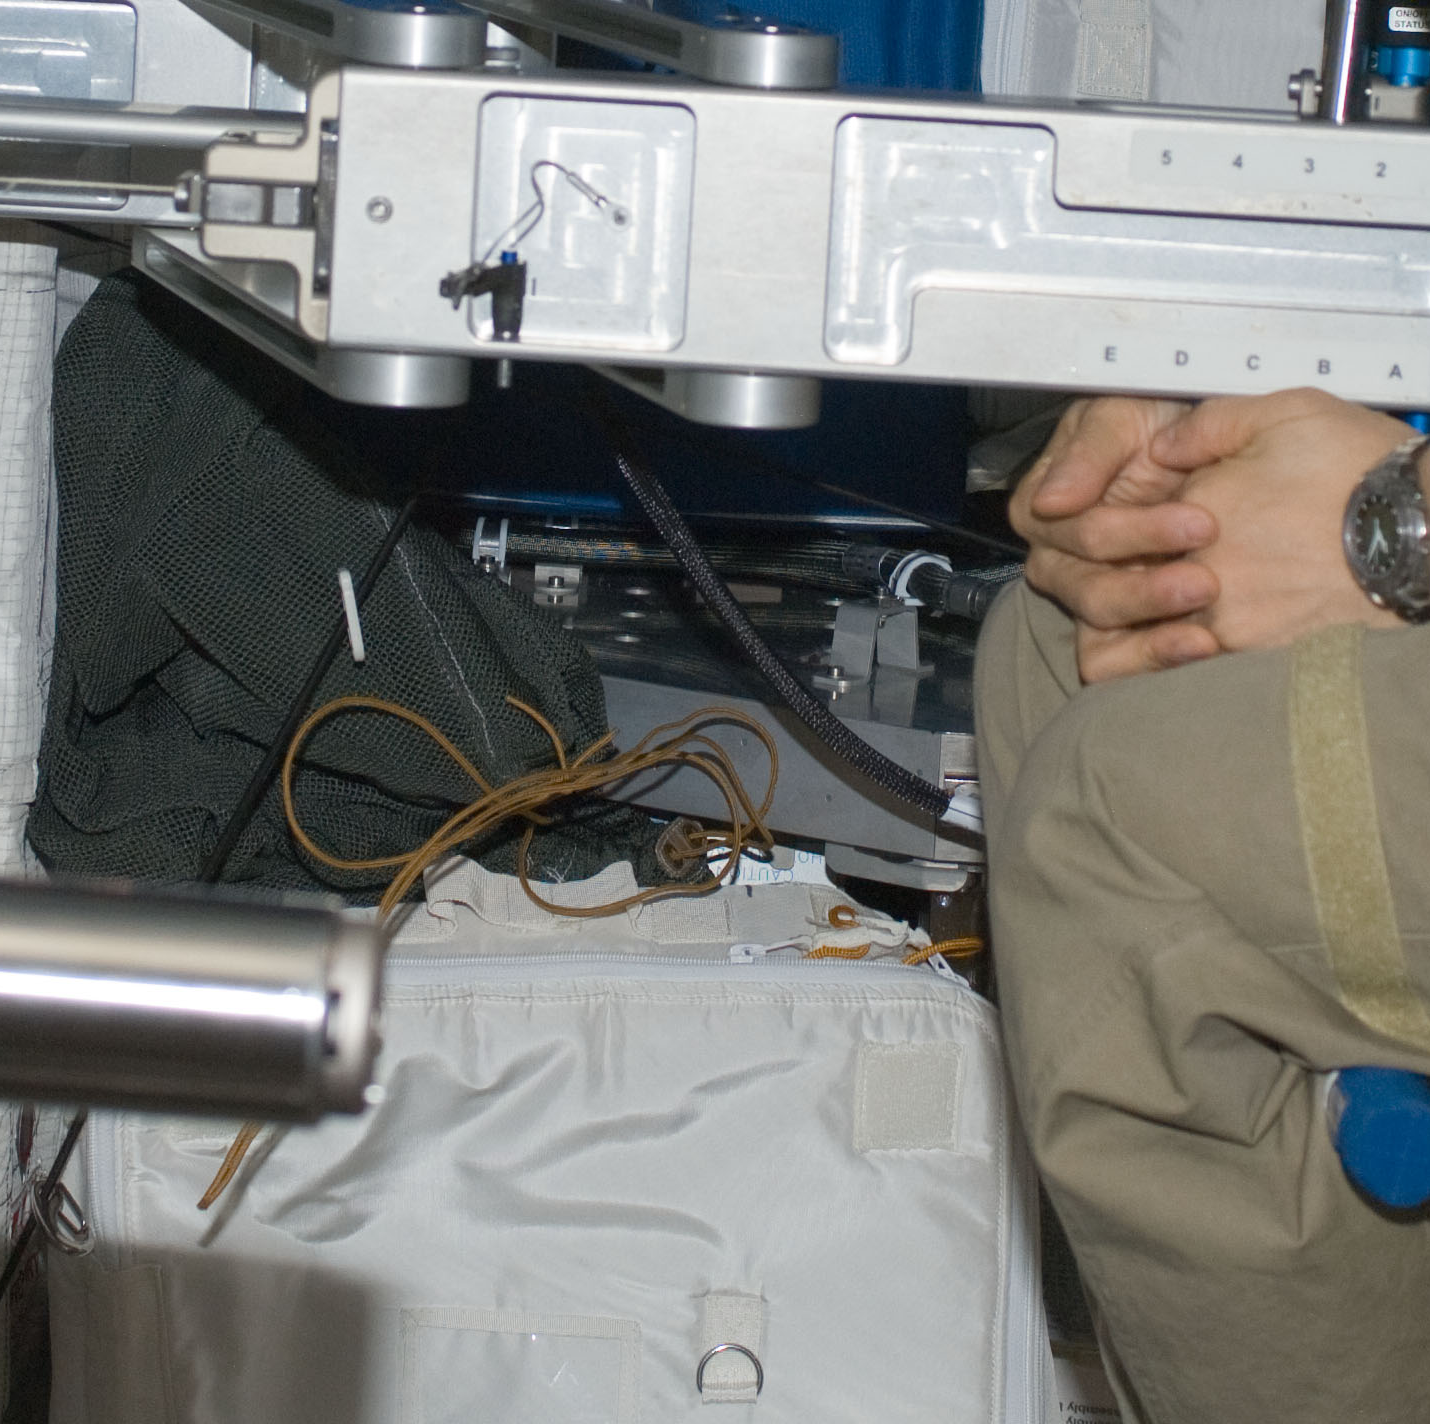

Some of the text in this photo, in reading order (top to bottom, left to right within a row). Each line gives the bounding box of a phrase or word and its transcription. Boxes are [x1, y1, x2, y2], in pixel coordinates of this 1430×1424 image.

[1161, 149, 1173, 166] 5
[1231, 154, 1244, 169] 4
[1303, 157, 1316, 174] 3
[1375, 162, 1387, 178] 2
[1104, 345, 1404, 381] E D C B A
